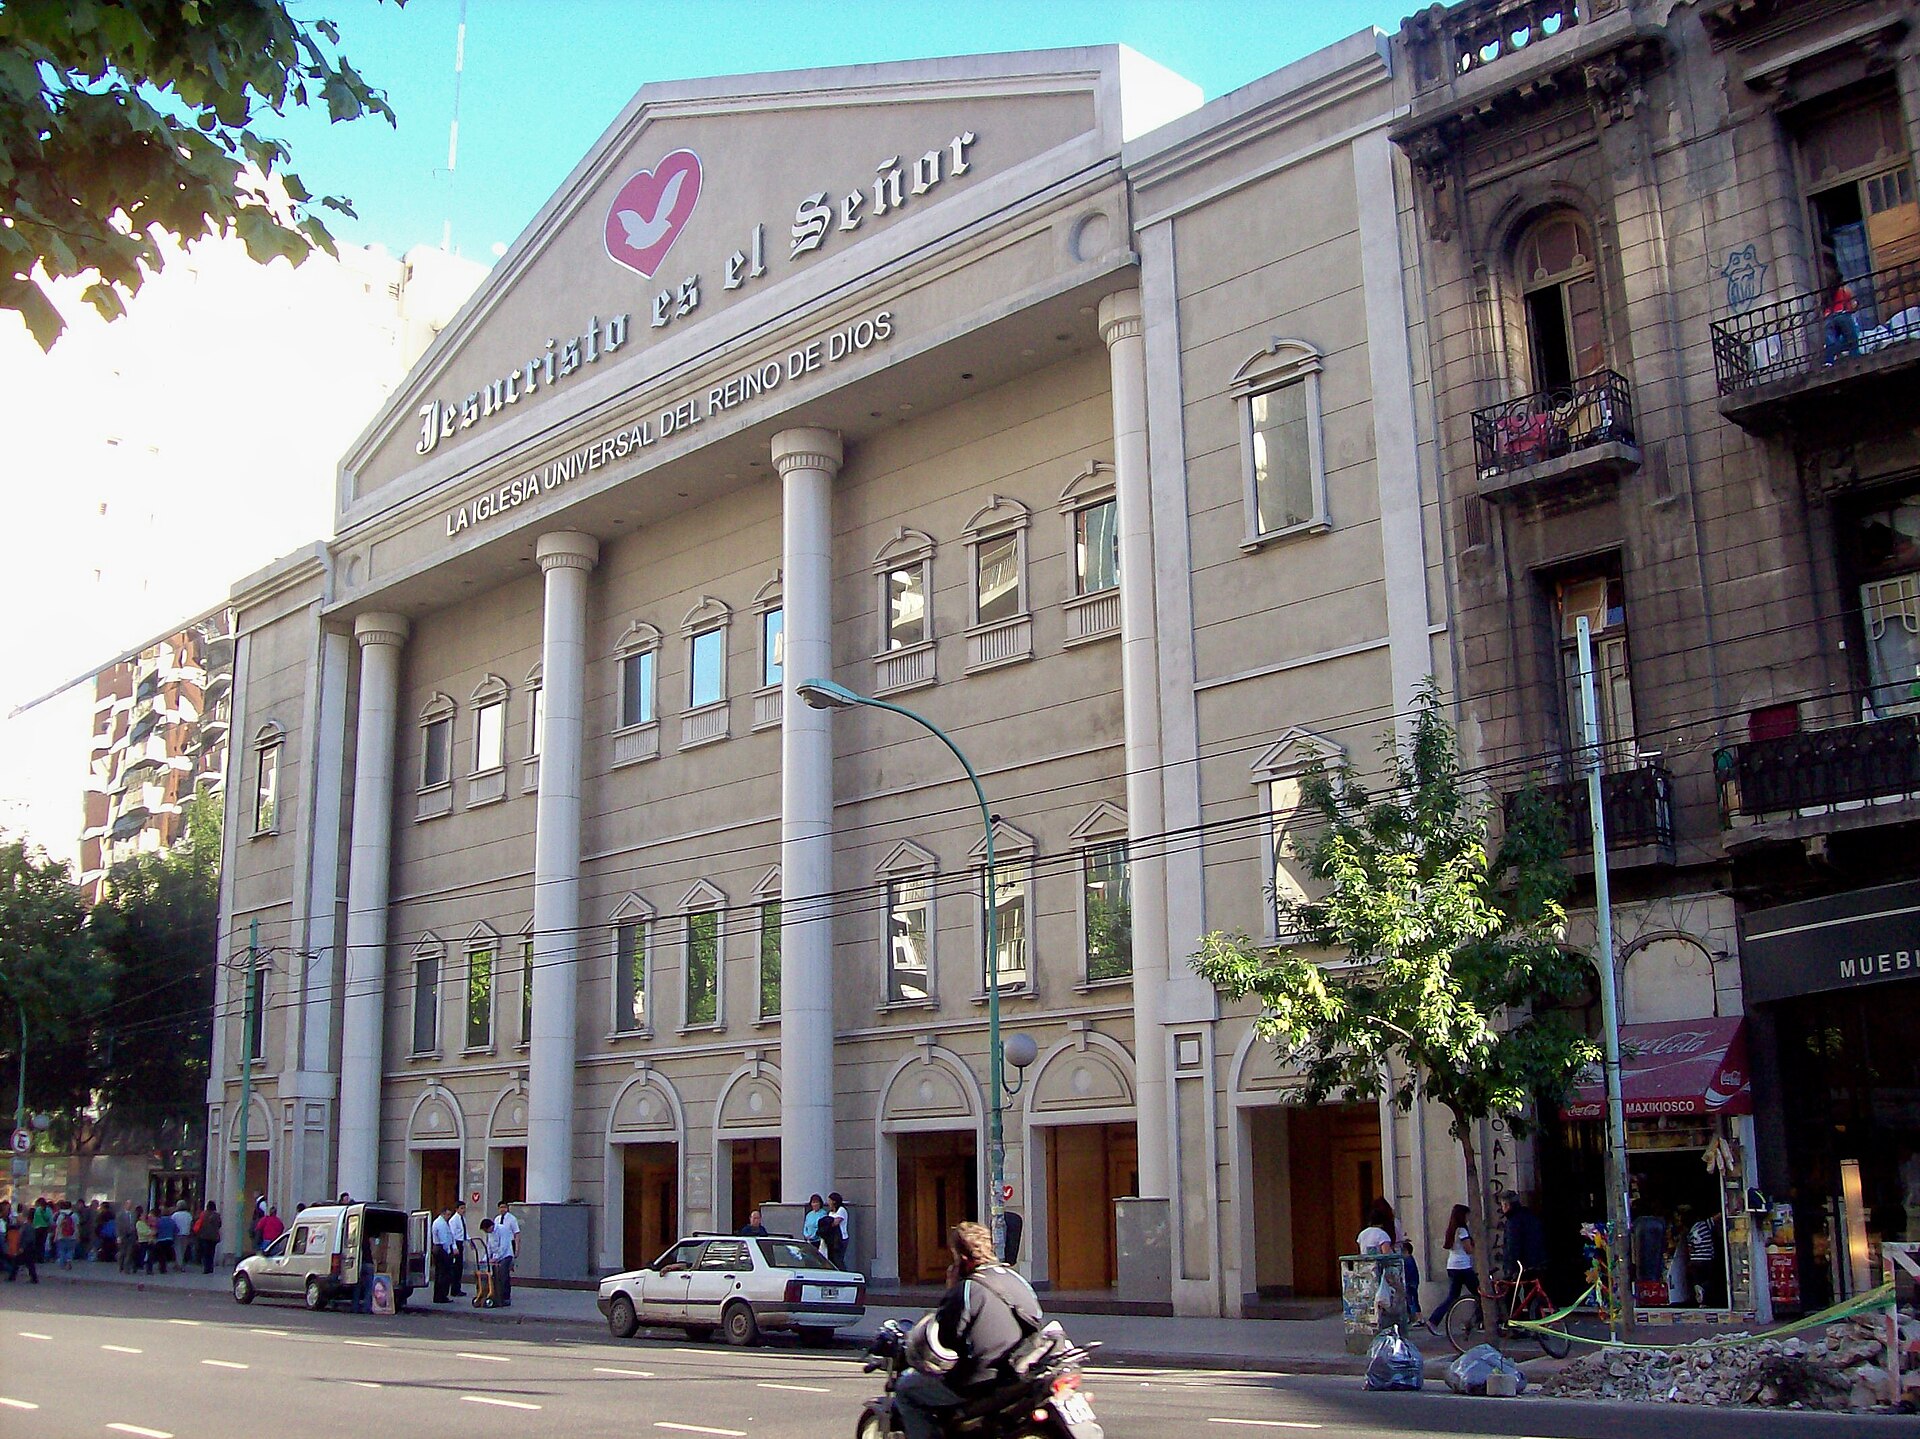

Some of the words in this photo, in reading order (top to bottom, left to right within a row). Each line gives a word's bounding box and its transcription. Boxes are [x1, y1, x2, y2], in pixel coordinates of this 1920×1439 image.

[416, 313, 631, 455] Jesucristo
[651, 274, 699, 328] es
[723, 223, 765, 290] el
[790, 130, 976, 262] Señor
[446, 508, 468, 537] LA
[472, 474, 540, 524] IGLESIA
[544, 421, 654, 490] UNIVERSAL
[660, 399, 702, 437] DEL
[708, 361, 781, 416] REINO
[788, 341, 821, 380] DE
[829, 311, 893, 362] DIOS
[1625, 1101, 1695, 1114] MAXIKIOSCO
